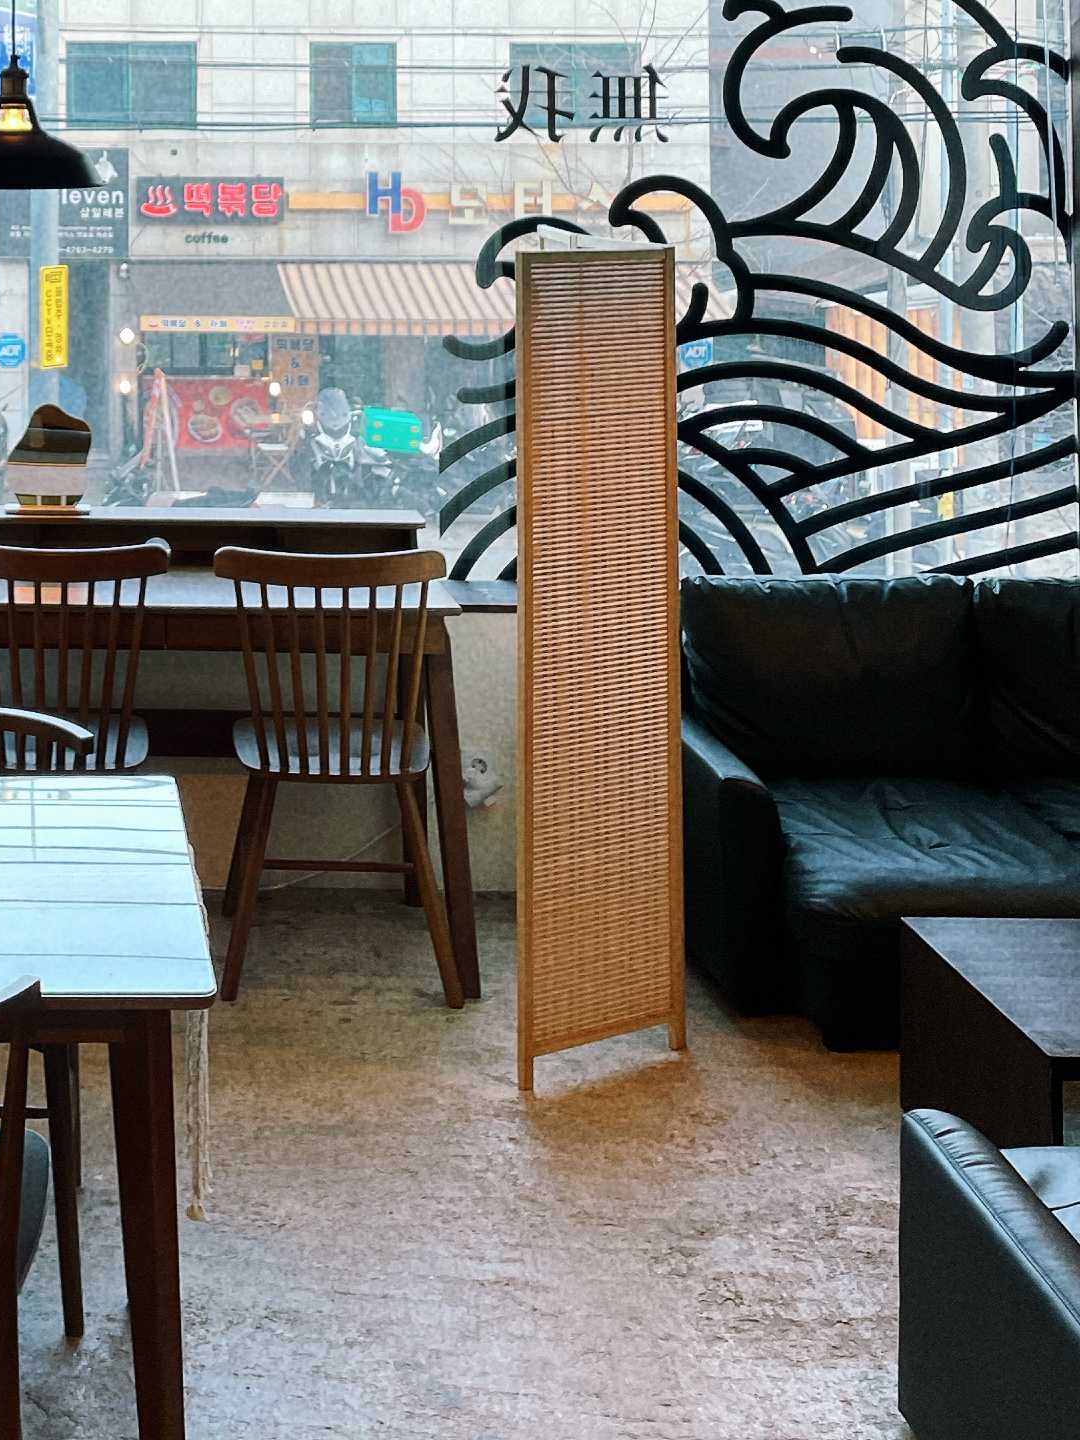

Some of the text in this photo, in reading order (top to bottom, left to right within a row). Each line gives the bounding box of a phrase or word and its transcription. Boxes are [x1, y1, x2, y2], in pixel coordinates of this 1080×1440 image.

[61, 188, 124, 204] leven
[184, 182, 281, 217] 떡볶당
[366, 171, 427, 234] HD
[185, 231, 229, 244] coffee
[685, 346, 707, 358] ADT
